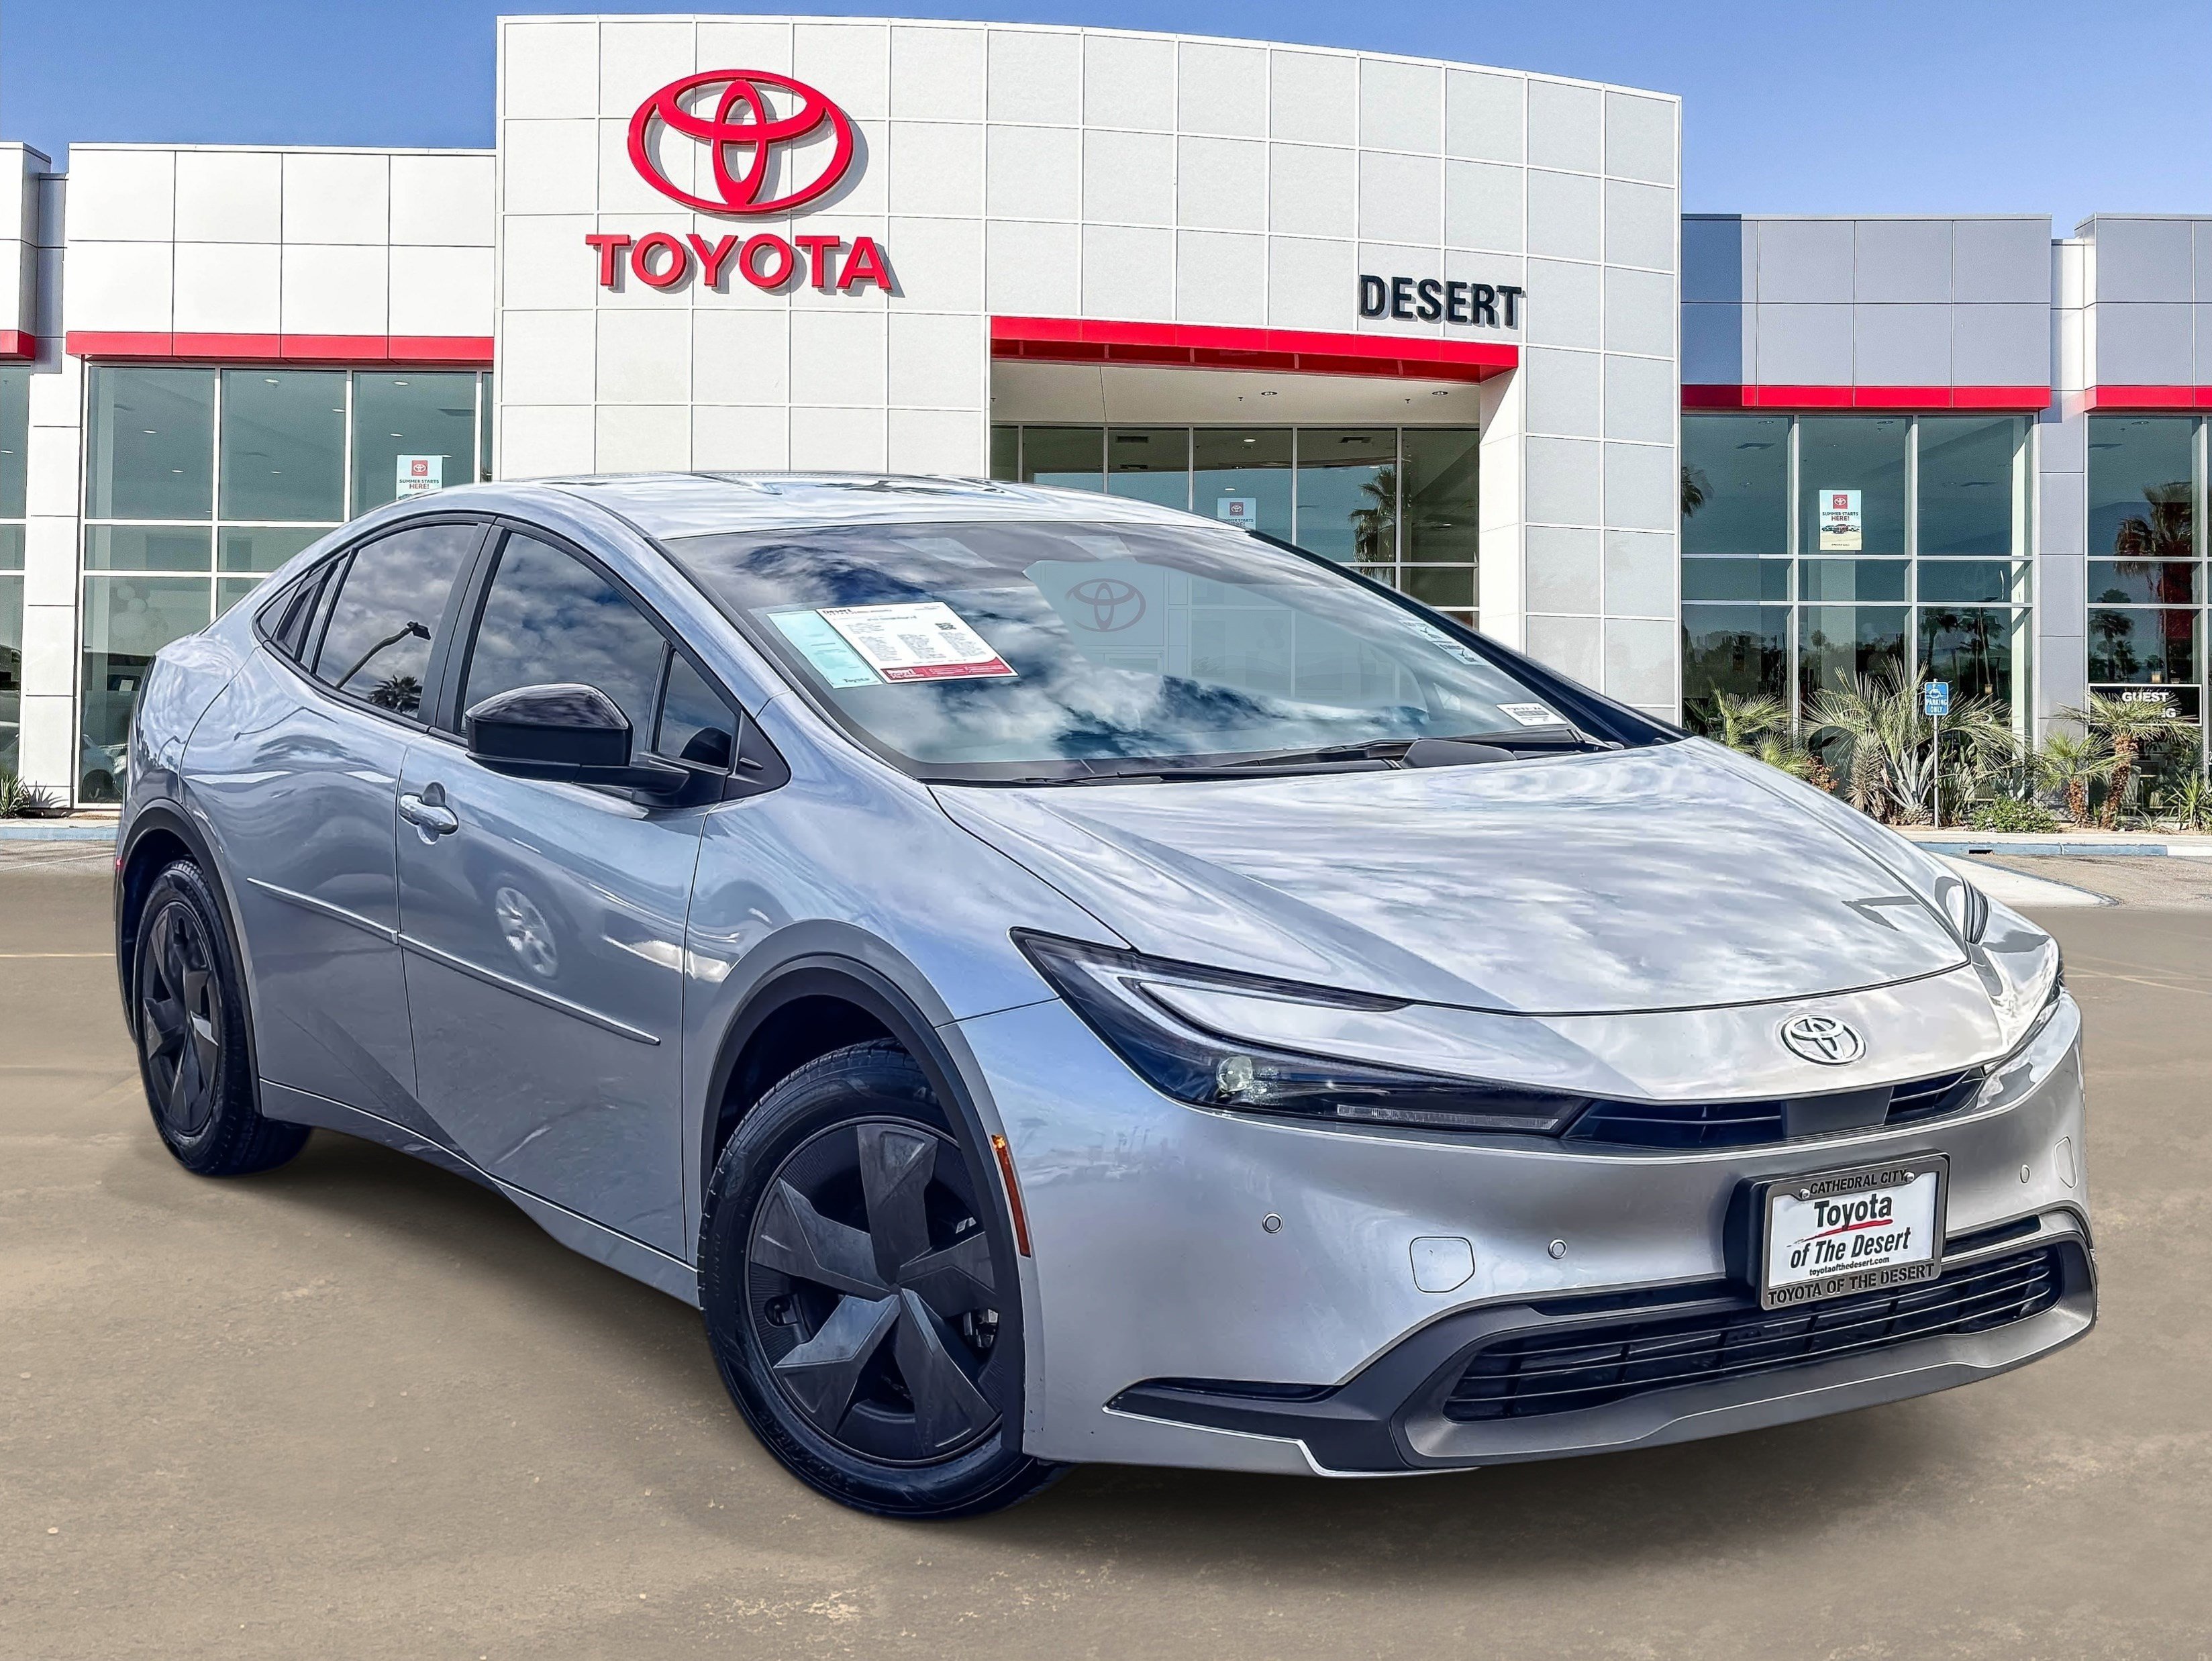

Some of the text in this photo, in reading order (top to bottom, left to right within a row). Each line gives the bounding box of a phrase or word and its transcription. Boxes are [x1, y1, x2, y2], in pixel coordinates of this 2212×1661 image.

[585, 232, 892, 290] TOYOTA
[1359, 274, 1522, 327] DESERT
[2121, 691, 2169, 703] GUEST
[1809, 1169, 1907, 1195] CATHEDRAL CITY
[1814, 1193, 1893, 1231] Toyota
[1790, 1227, 1911, 1268] of The Desert
[1809, 1256, 1890, 1276] toyotaofthedesert.com
[1768, 1263, 1935, 1305] TOYOTA OF THE DESERT
